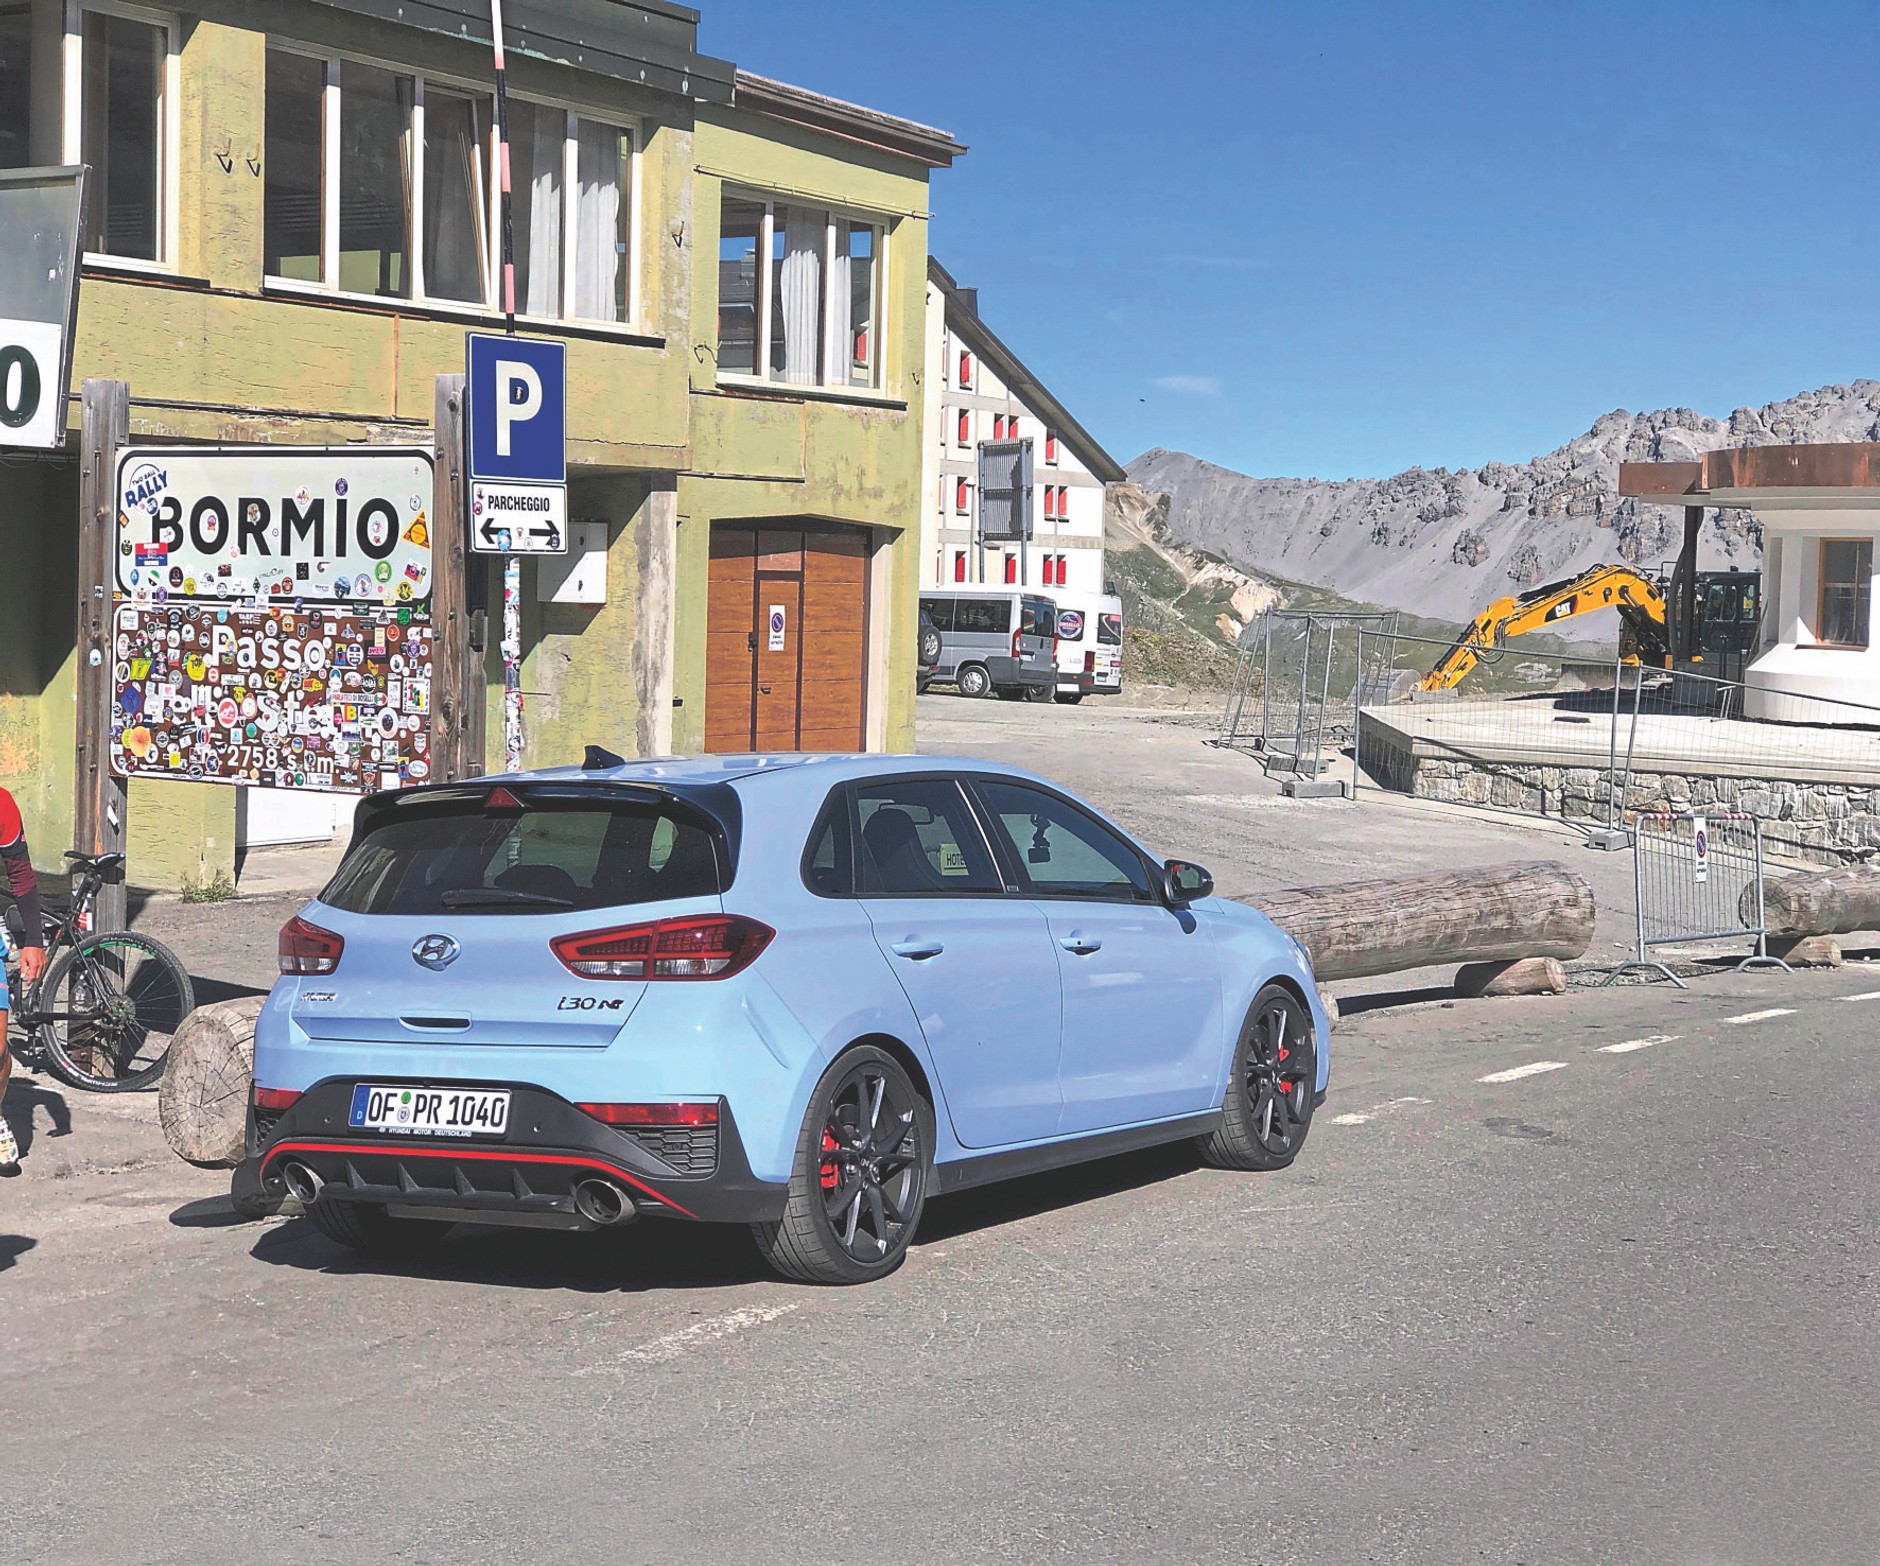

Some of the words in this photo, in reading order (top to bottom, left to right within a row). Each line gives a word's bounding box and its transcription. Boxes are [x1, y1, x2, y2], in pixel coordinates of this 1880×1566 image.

[496, 360, 542, 456] P
[125, 470, 168, 508] RALLY
[488, 495, 550, 512] PARCHEGGIO
[152, 496, 399, 559] BORMIO
[1555, 602, 1570, 617] CAT
[212, 625, 326, 671] Passo
[227, 745, 277, 769] 2758
[356, 1110, 363, 1120] D
[368, 1092, 398, 1122] OF
[413, 1094, 442, 1124] PR
[446, 1096, 505, 1127] 1040
[434, 1129, 472, 1137] DEUTSCHLAND
